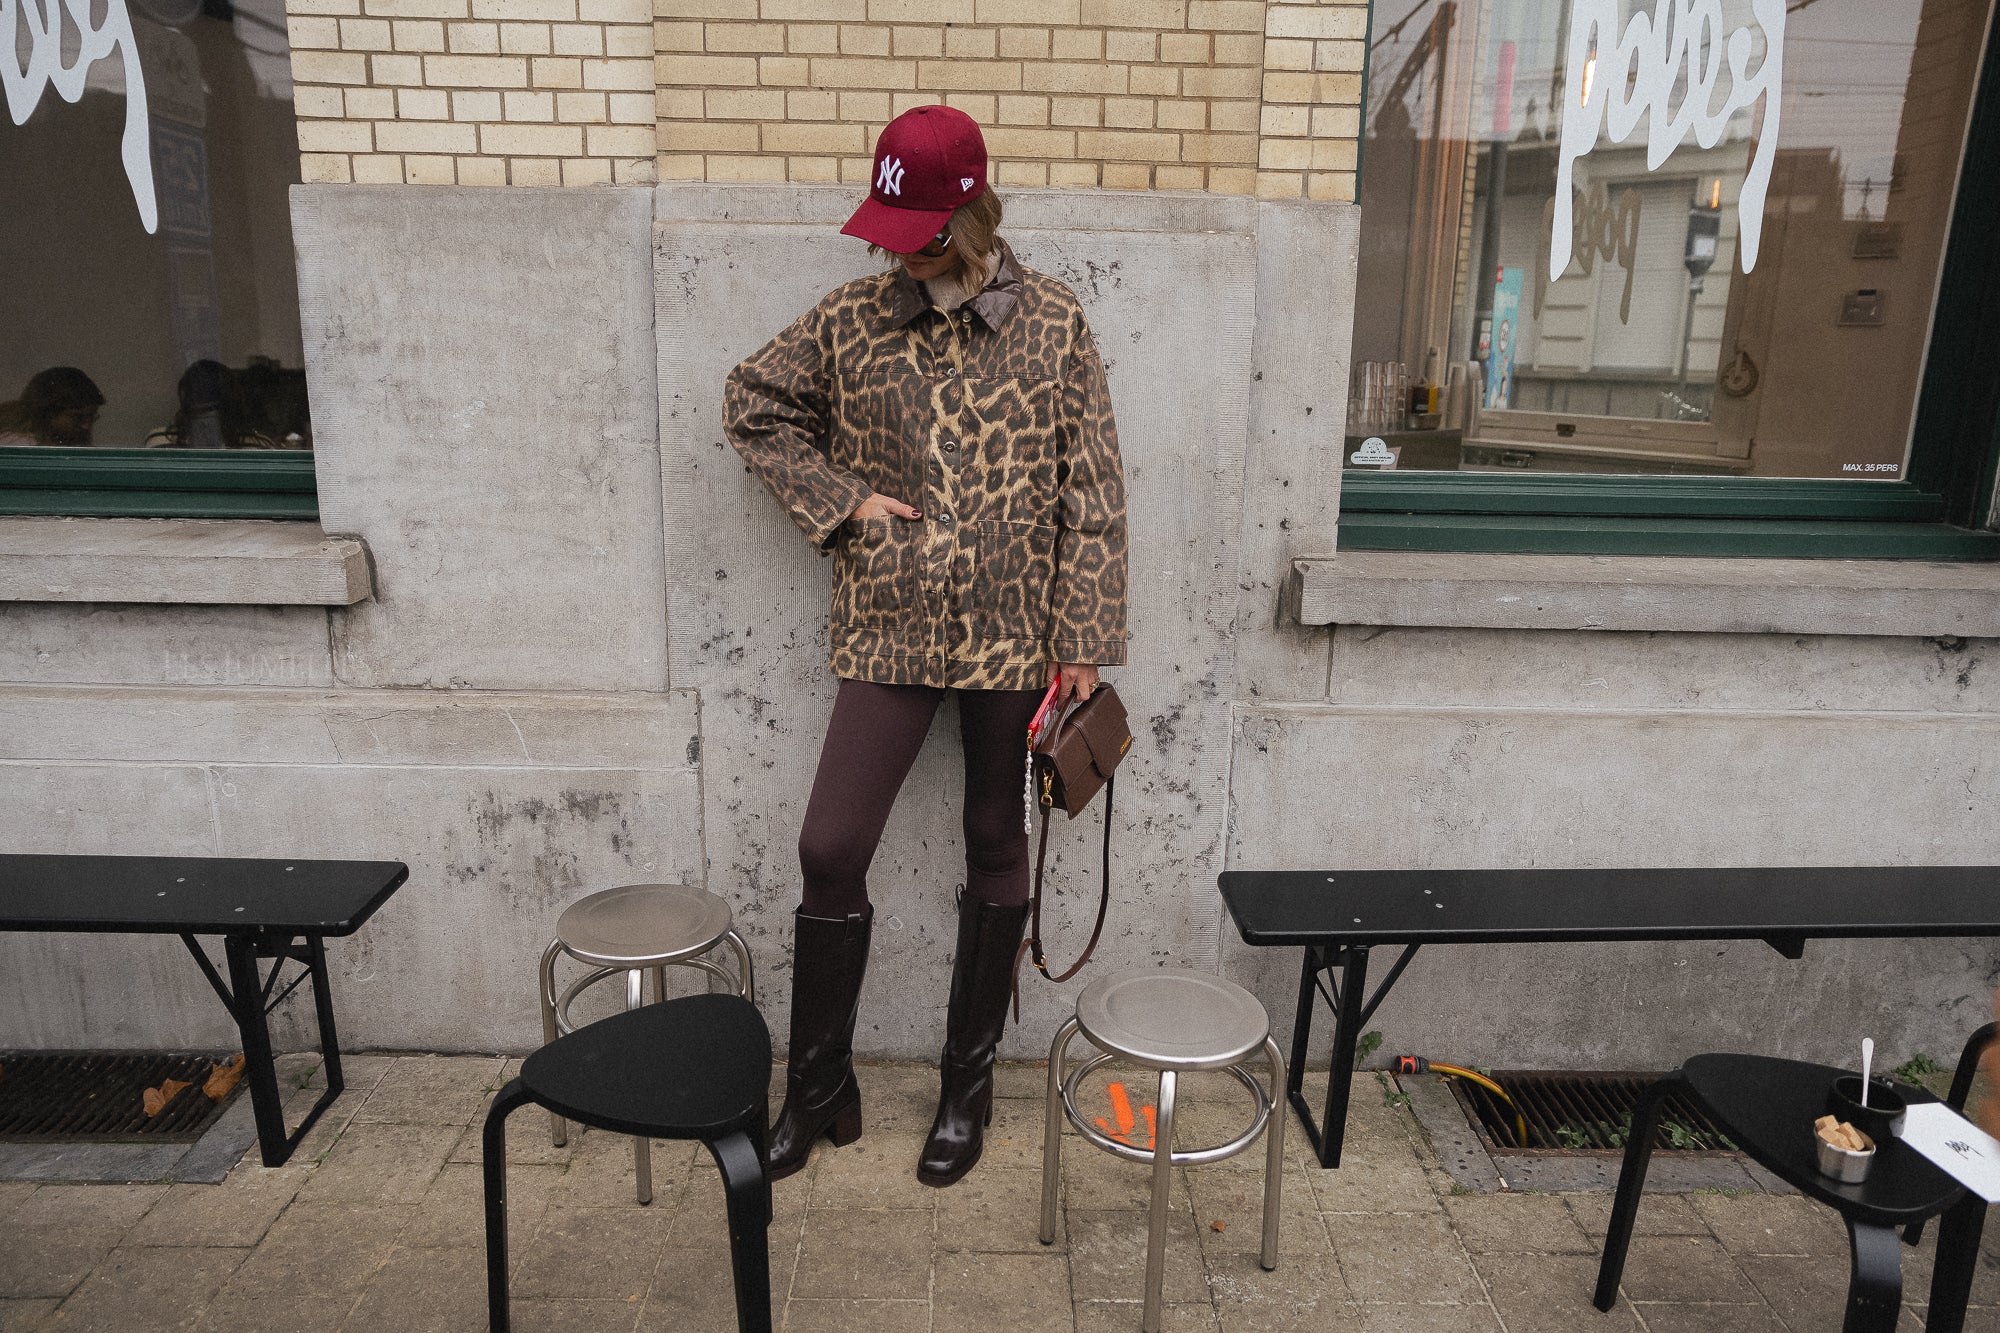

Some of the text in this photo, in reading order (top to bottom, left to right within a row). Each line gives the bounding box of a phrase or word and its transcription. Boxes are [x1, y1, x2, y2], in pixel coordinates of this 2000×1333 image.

[876, 154, 906, 197] NY
[1842, 463, 1899, 472] MAX. 35 PERS
